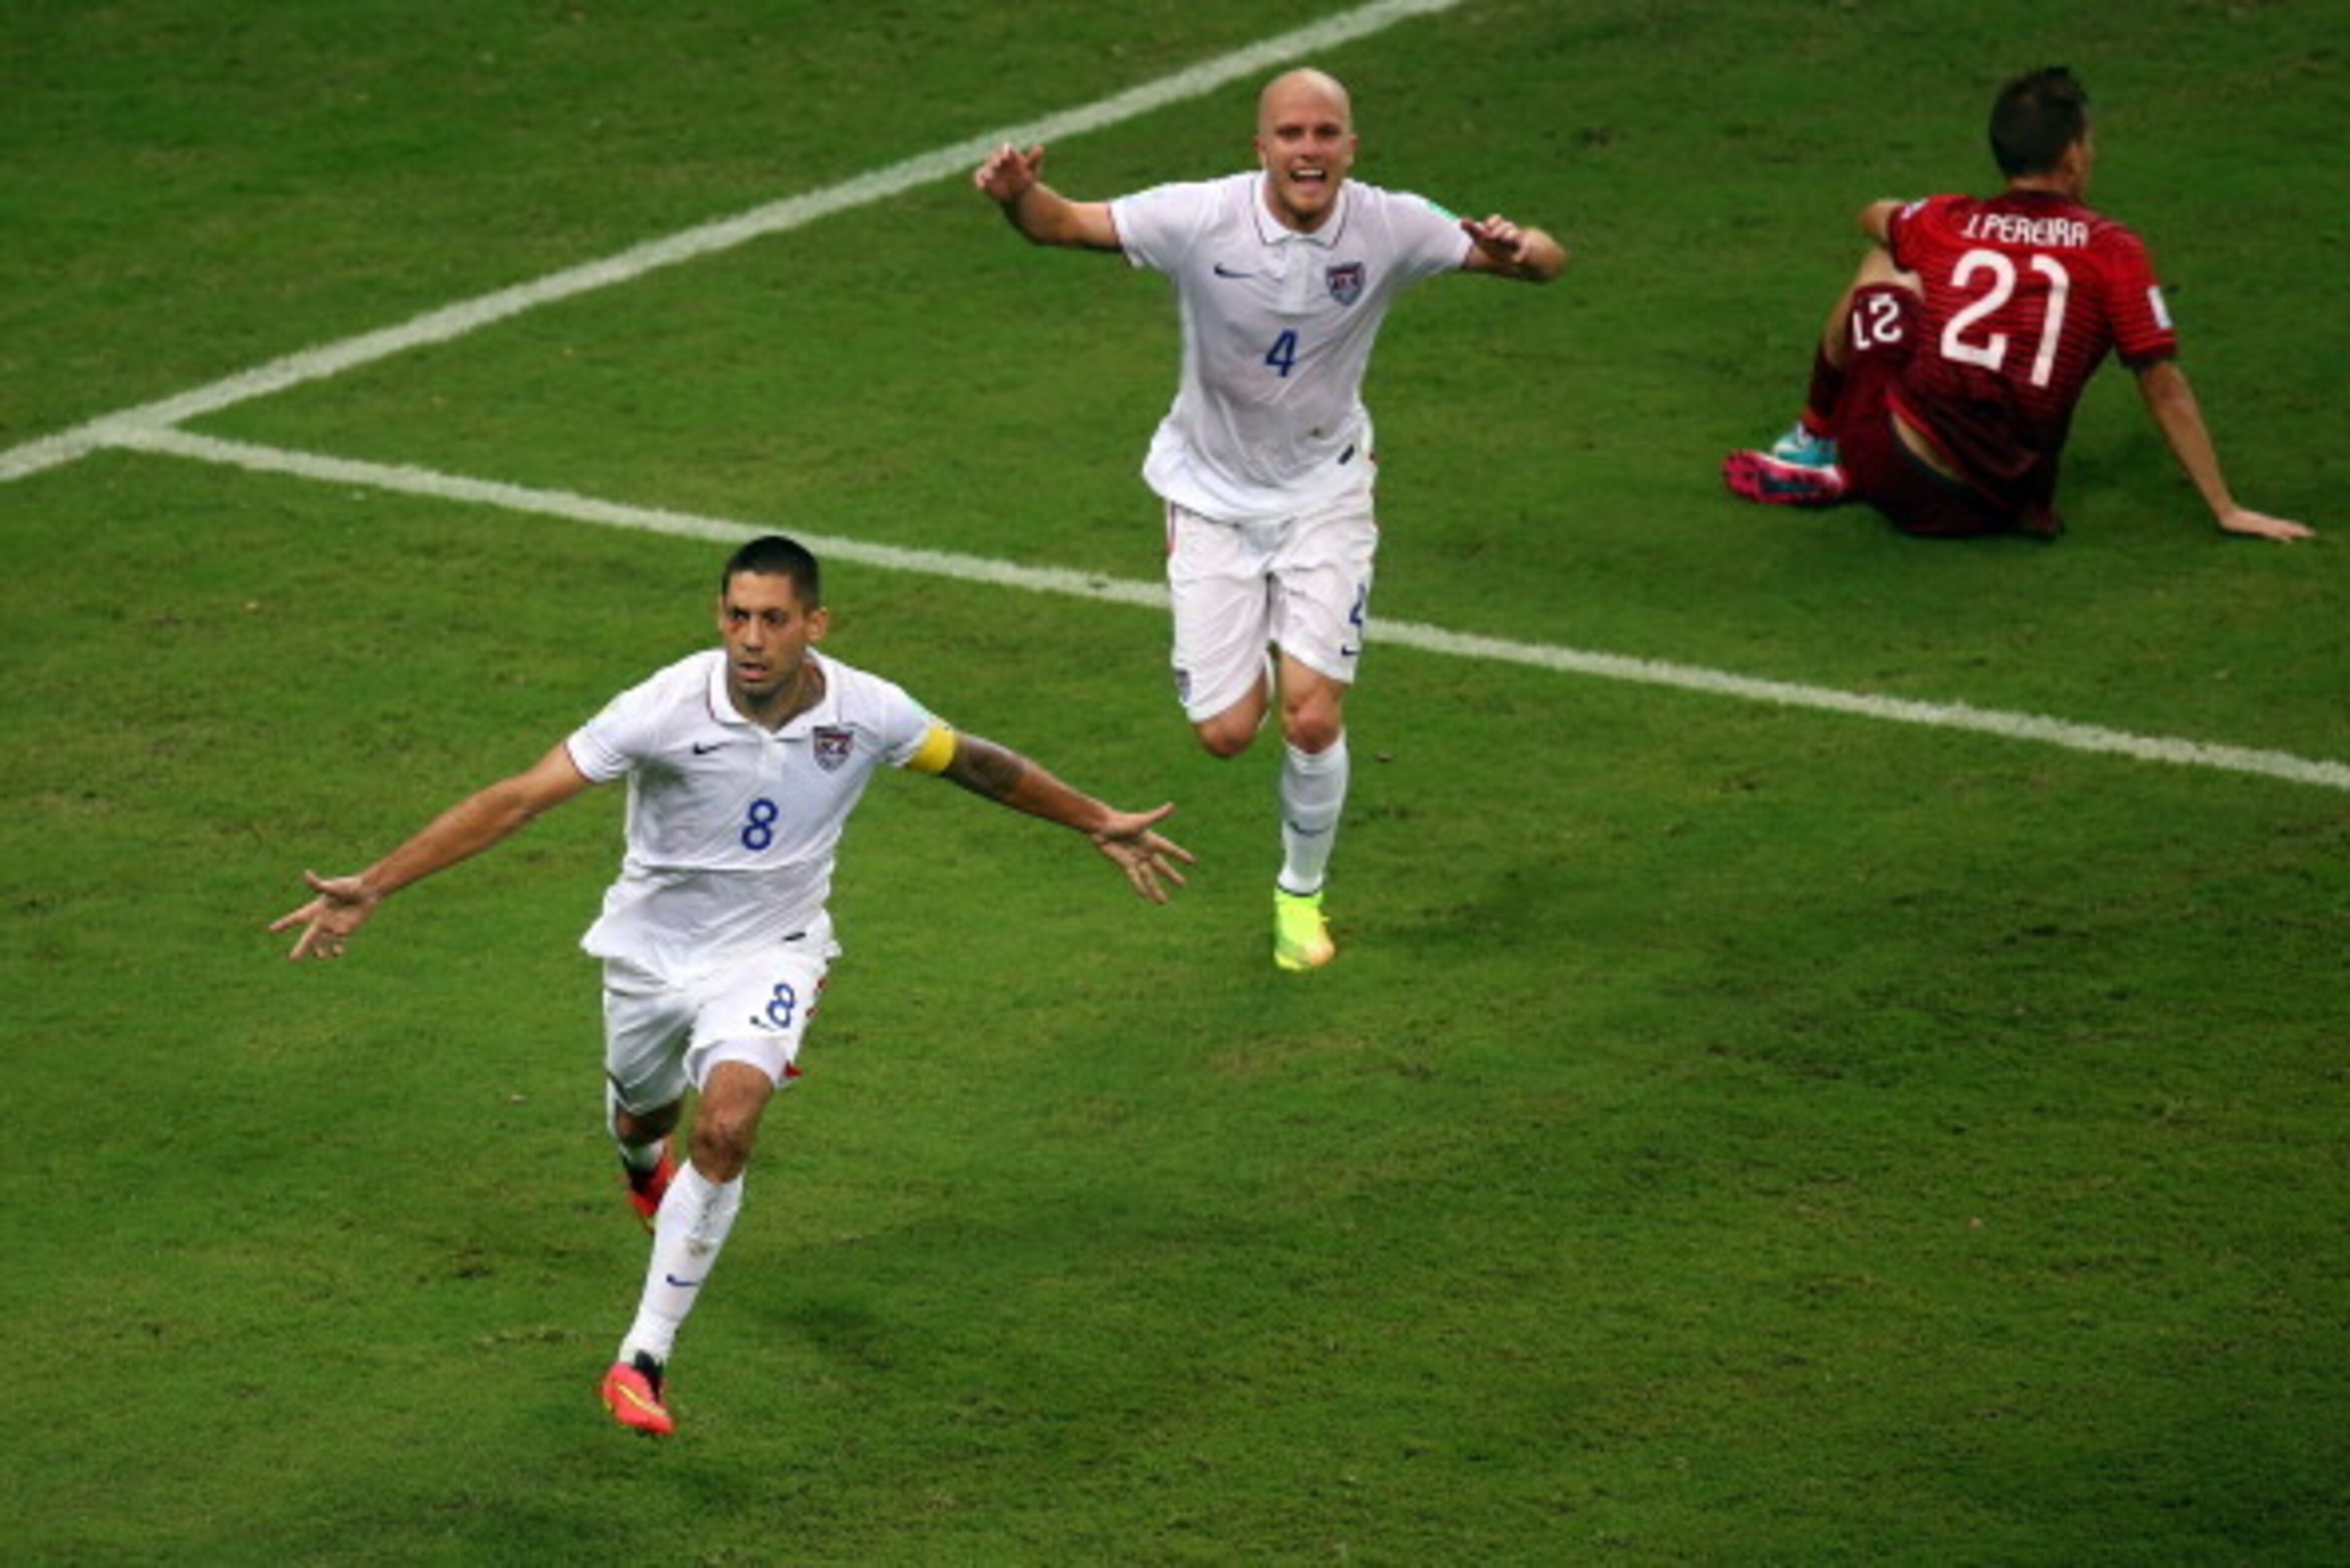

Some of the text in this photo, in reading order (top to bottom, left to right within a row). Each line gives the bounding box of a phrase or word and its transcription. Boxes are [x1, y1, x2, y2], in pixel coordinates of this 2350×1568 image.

[1943, 248, 2070, 388] 21
[1265, 328, 1297, 378] 4
[741, 797, 778, 851] 8
[765, 982, 795, 1029] 8
